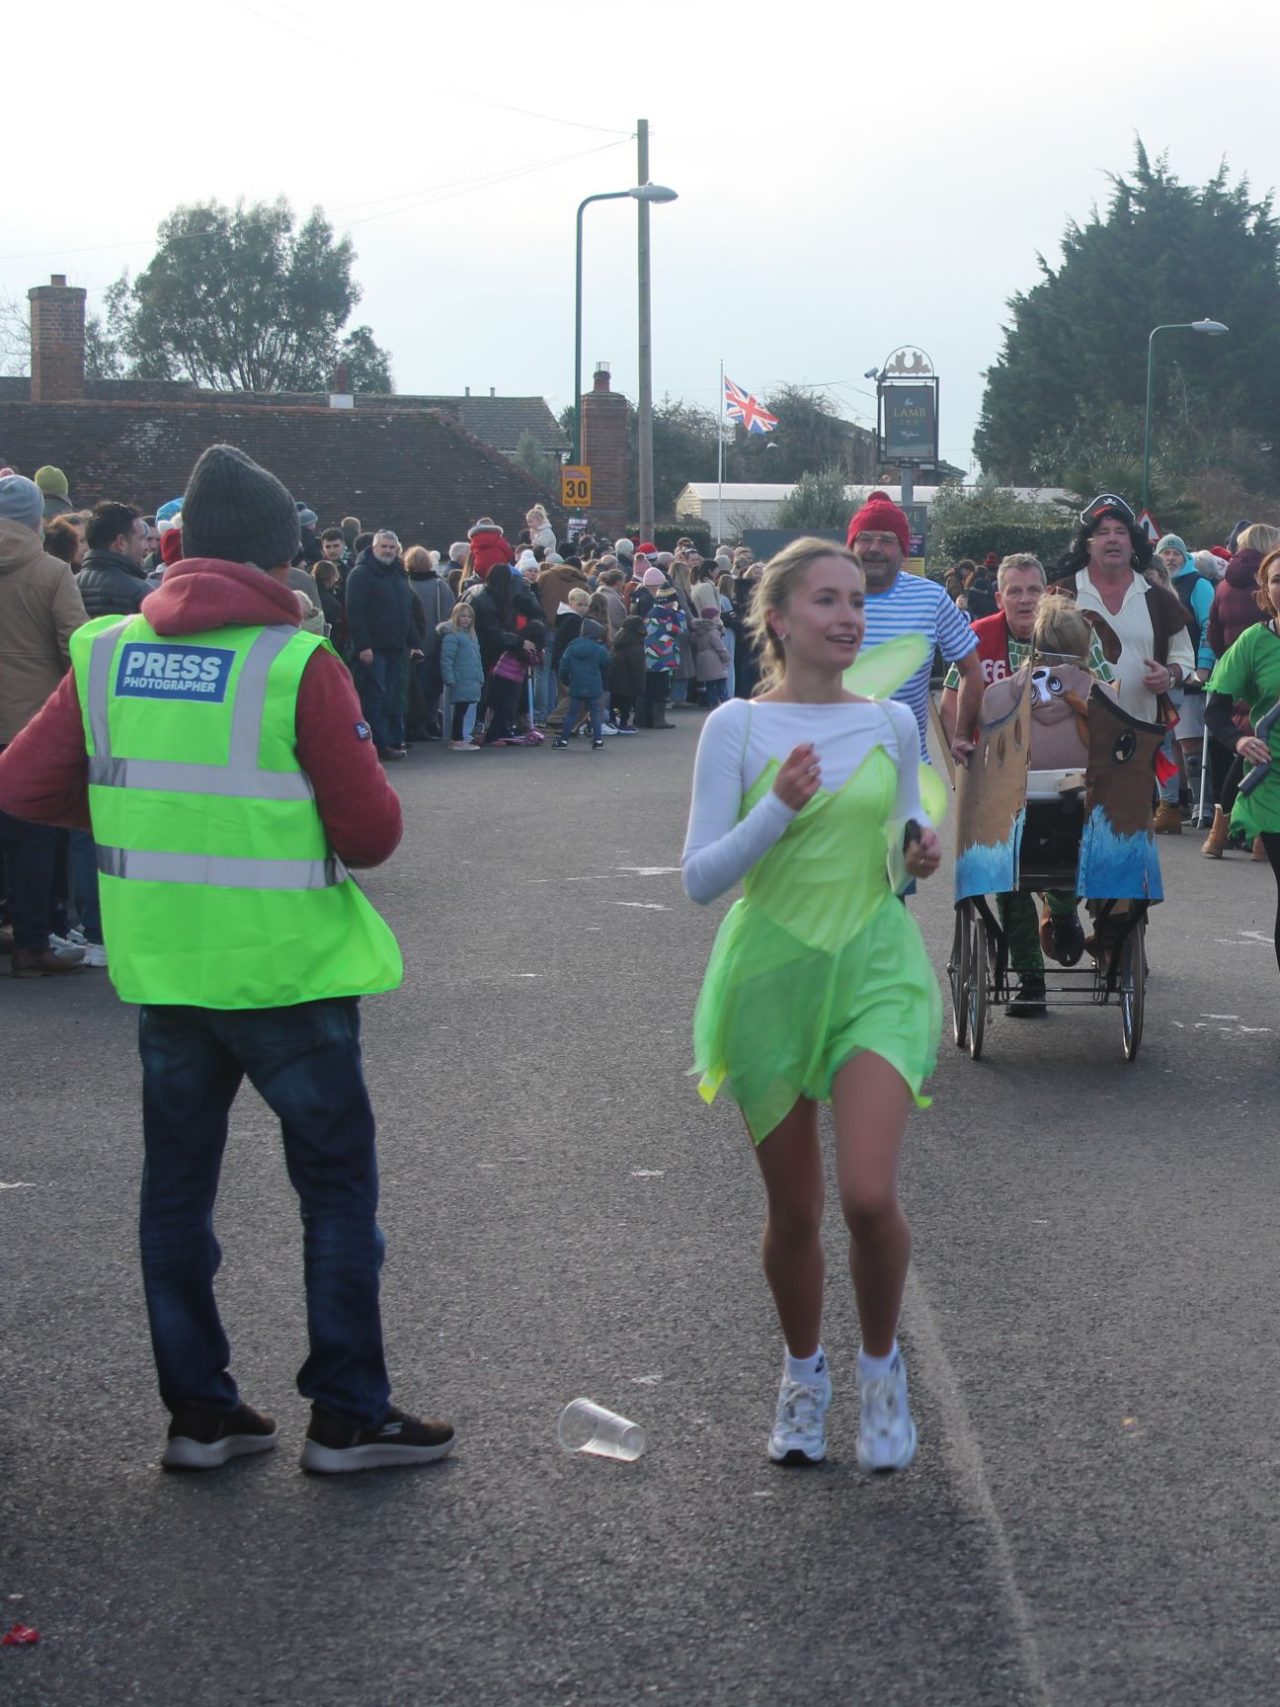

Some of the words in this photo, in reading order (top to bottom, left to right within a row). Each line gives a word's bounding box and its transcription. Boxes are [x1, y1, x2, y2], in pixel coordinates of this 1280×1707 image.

[894, 408, 926, 417] LAMB
[566, 481, 587, 498] 30
[125, 651, 222, 681] PRESS
[123, 676, 217, 693] PHOTOGRAPHER
